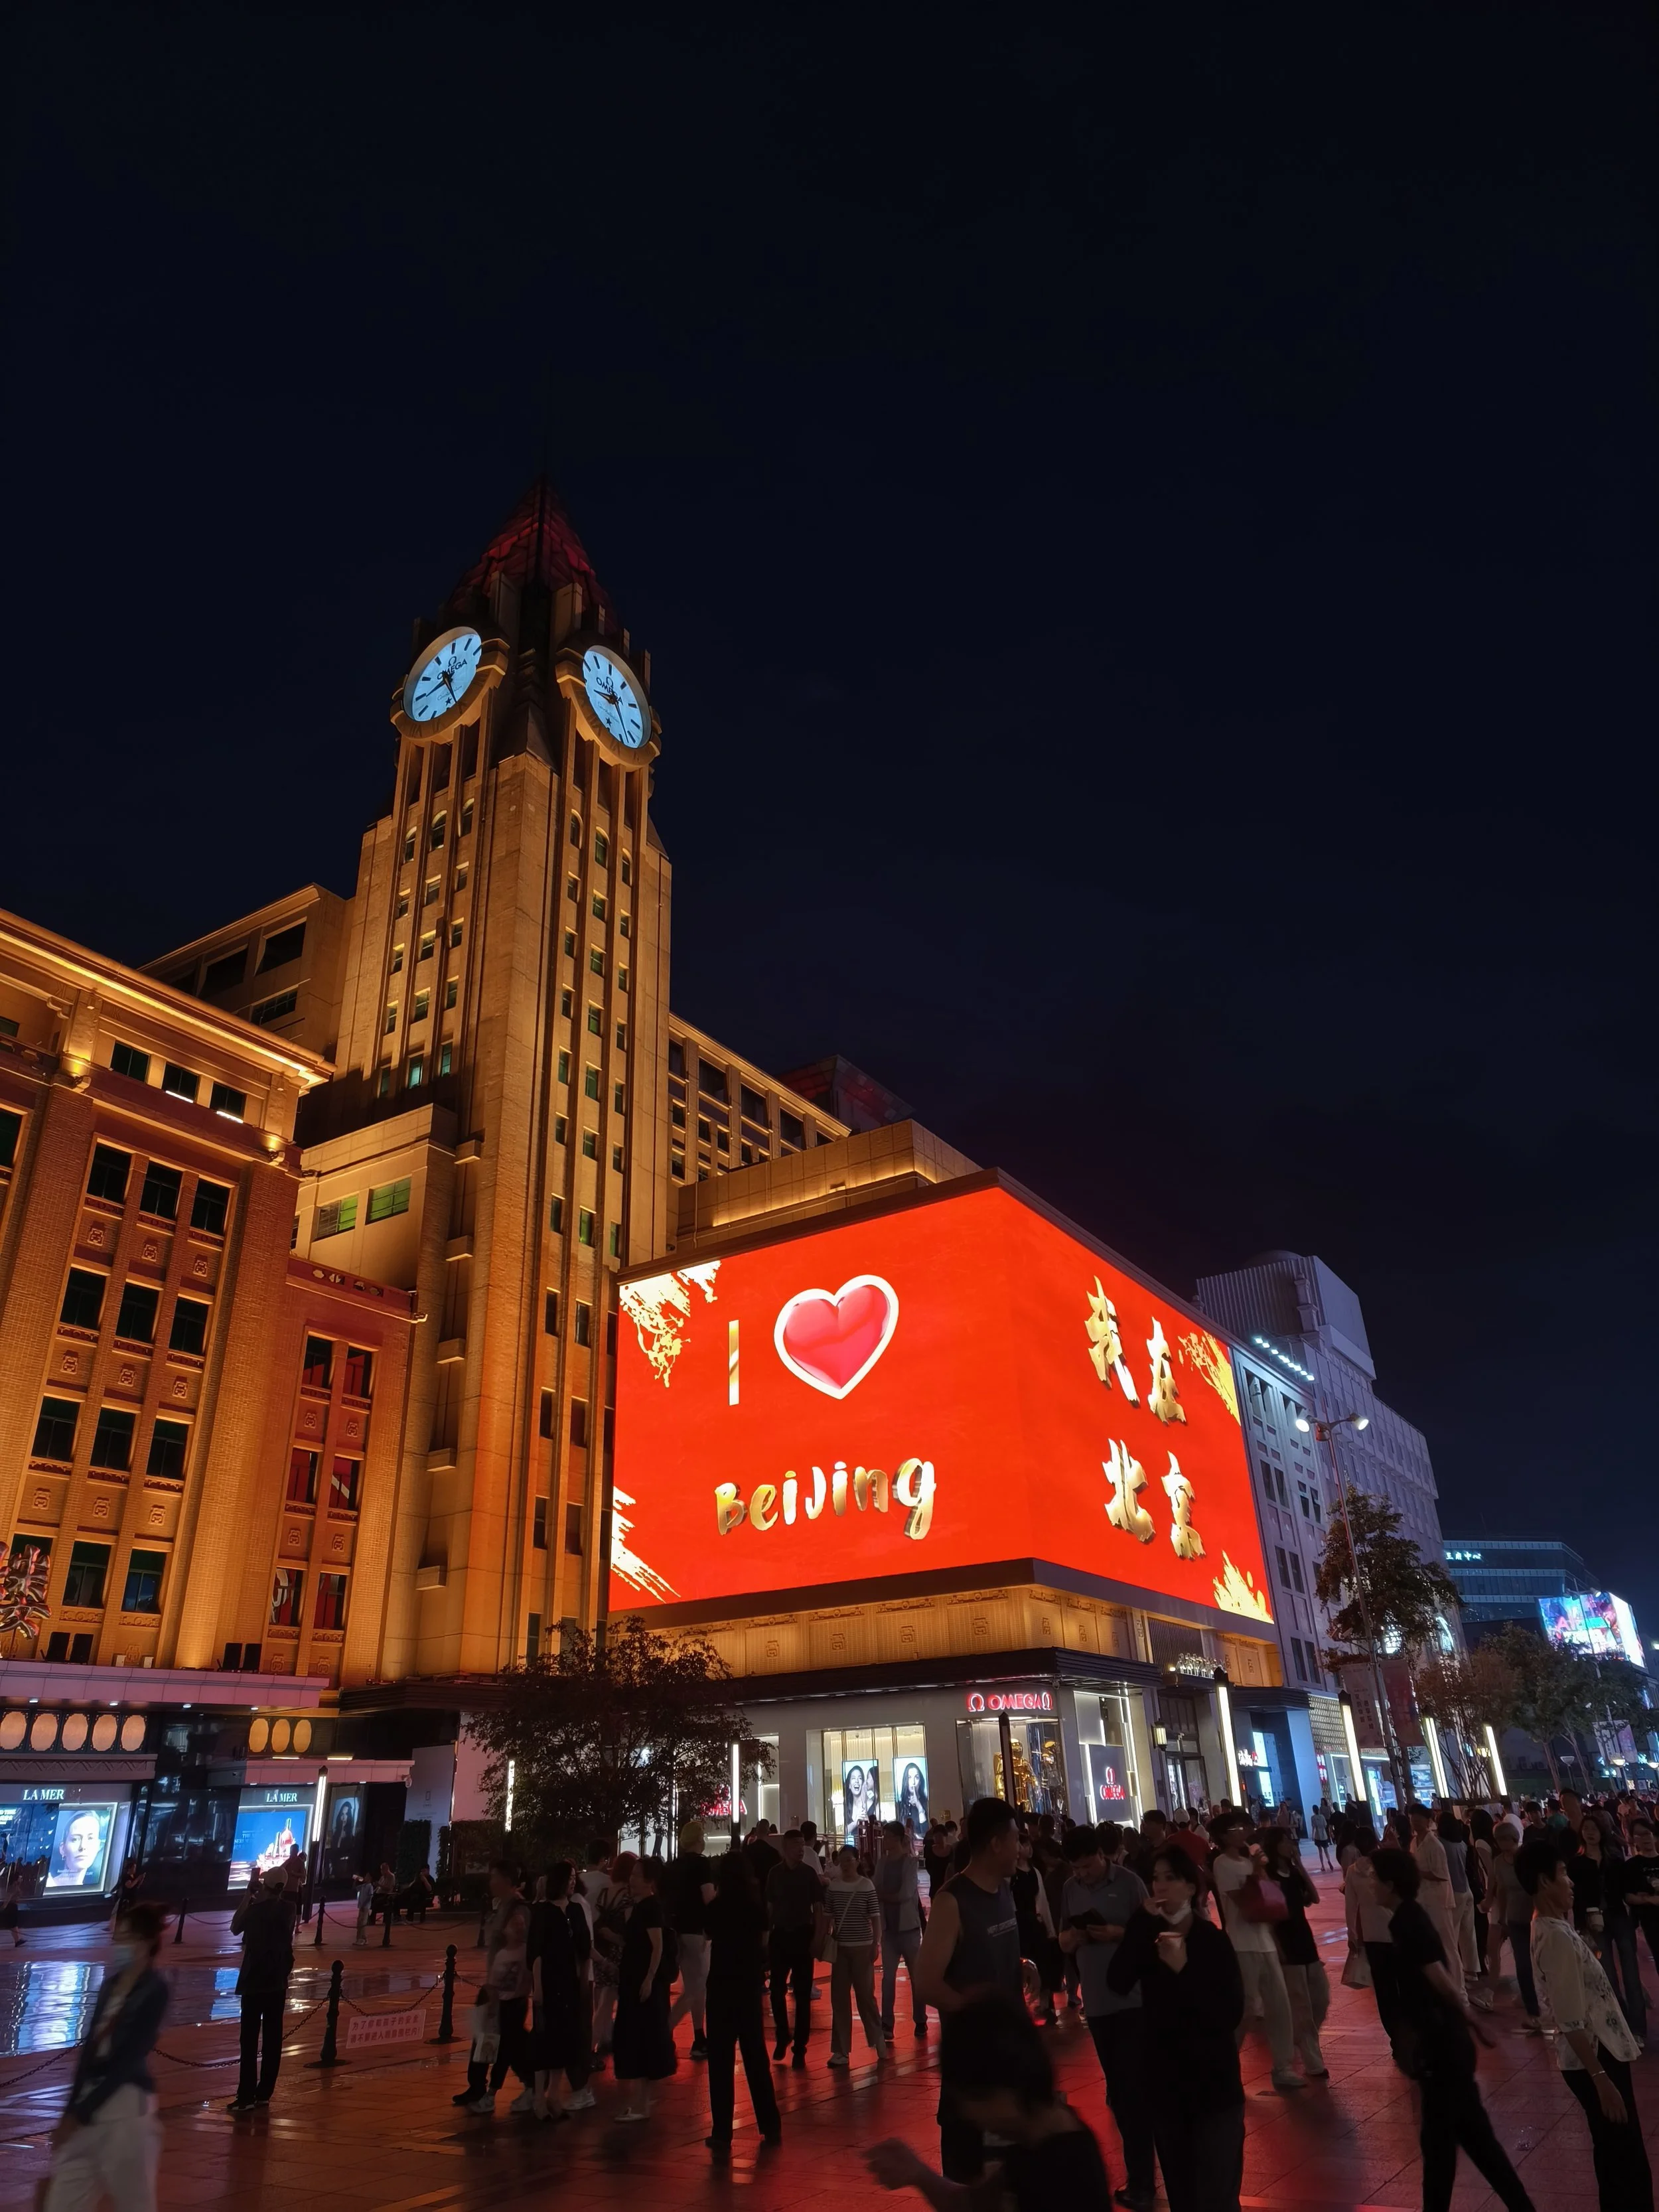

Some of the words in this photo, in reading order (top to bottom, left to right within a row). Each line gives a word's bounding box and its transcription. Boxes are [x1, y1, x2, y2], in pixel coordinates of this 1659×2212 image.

[728, 1319, 740, 1406] I
[1102, 1438, 1206, 1558] 北京
[987, 1693, 1041, 1710] OMEGA
[23, 1789, 38, 1801] LA
[40, 1789, 64, 1801] MER
[266, 1793, 278, 1803] LA
[279, 1793, 297, 1803] MER
